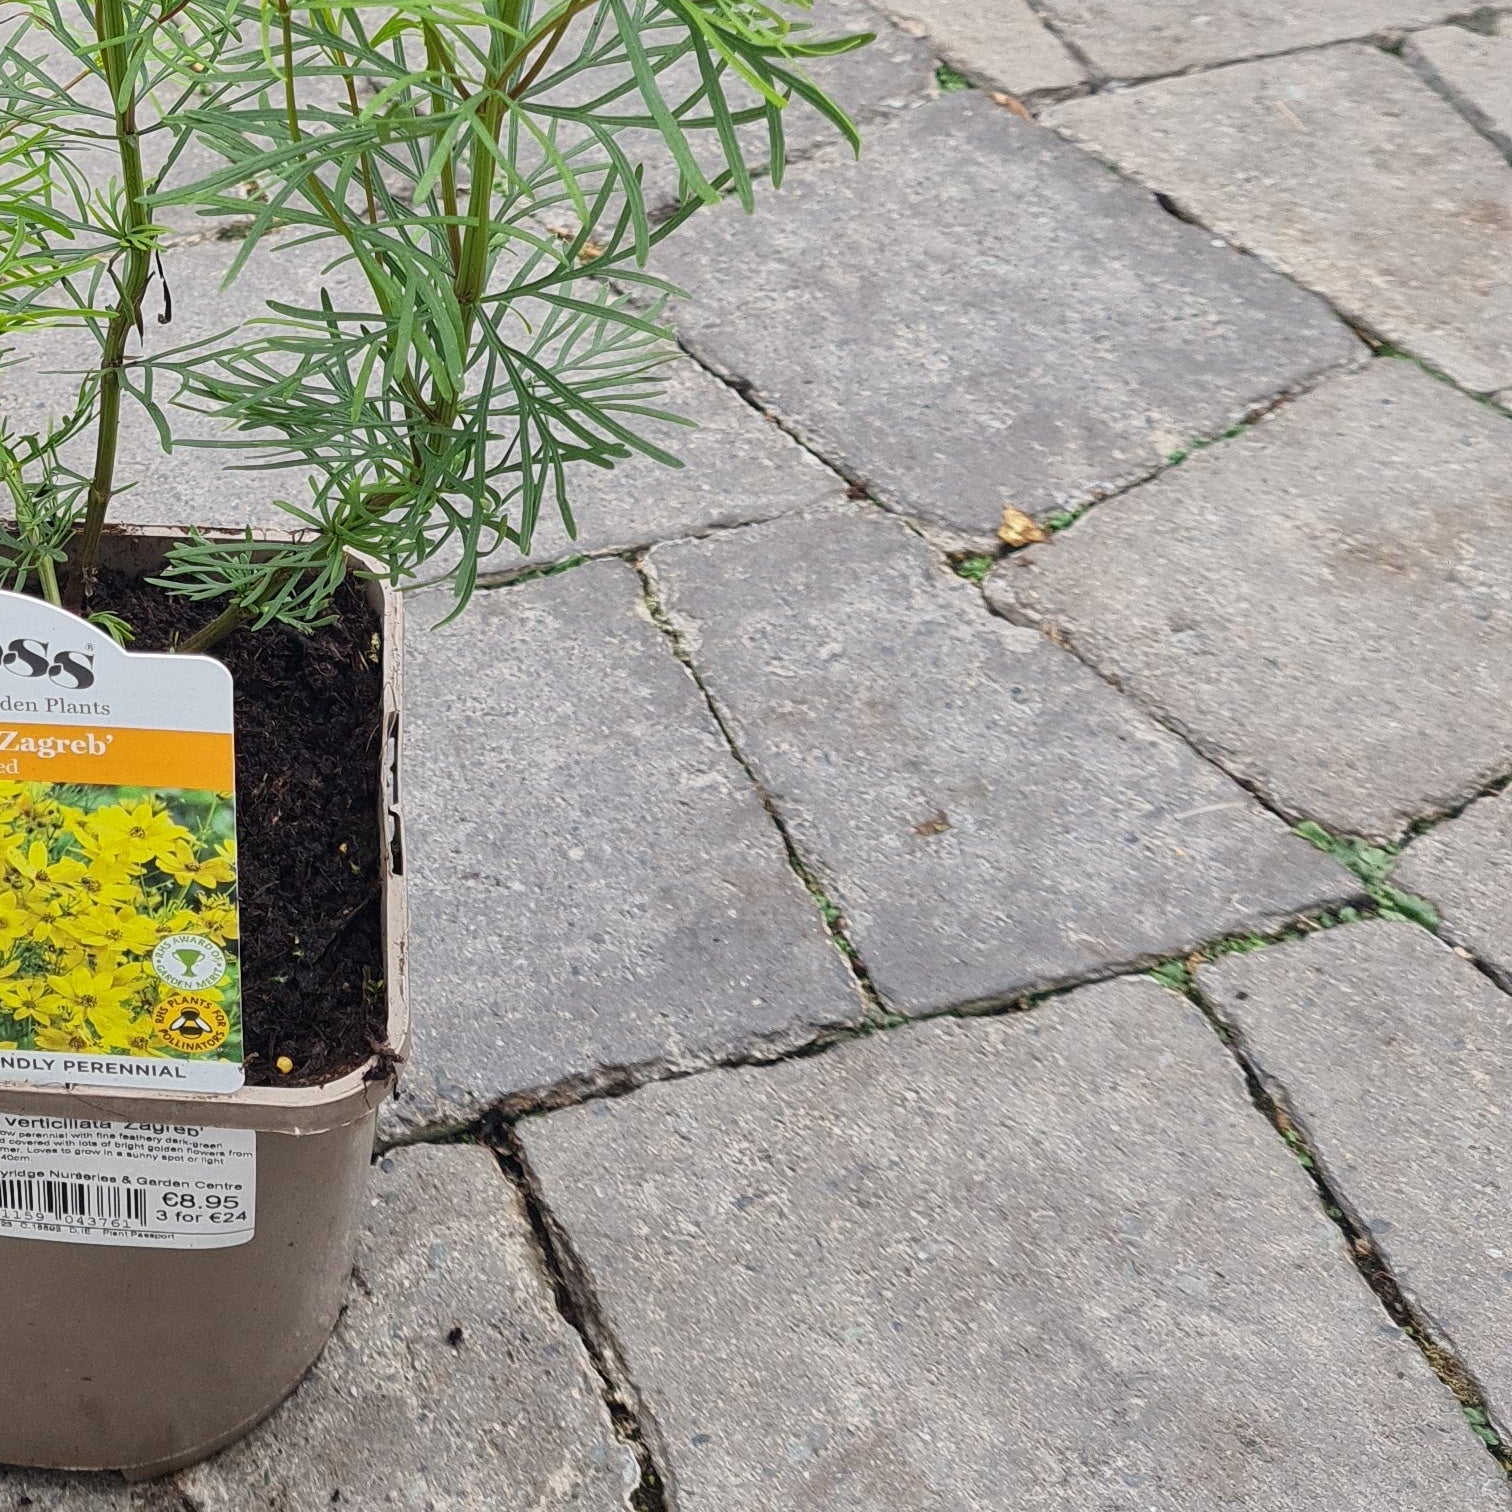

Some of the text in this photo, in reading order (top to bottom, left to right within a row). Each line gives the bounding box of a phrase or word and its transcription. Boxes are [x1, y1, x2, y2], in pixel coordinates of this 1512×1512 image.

[45, 697, 111, 716] Plants
[155, 935, 223, 964] RHS AWARD OF
[157, 966, 223, 989] GARDEN MERIT
[155, 996, 227, 1027] RHS PLANTS FOR
[158, 1028, 225, 1051] POLLINATORS
[64, 1060, 187, 1079] PERENNIAL
[228, 1150, 254, 1158] from
[50, 1170, 117, 1184] Nurseries
[121, 1175, 132, 1186] &
[136, 1176, 190, 1189] Garden
[194, 1180, 243, 1191] Centre
[162, 1191, 240, 1210] €8.95
[64, 1214, 132, 1229] 043761
[155, 1209, 248, 1224] 3 for €24
